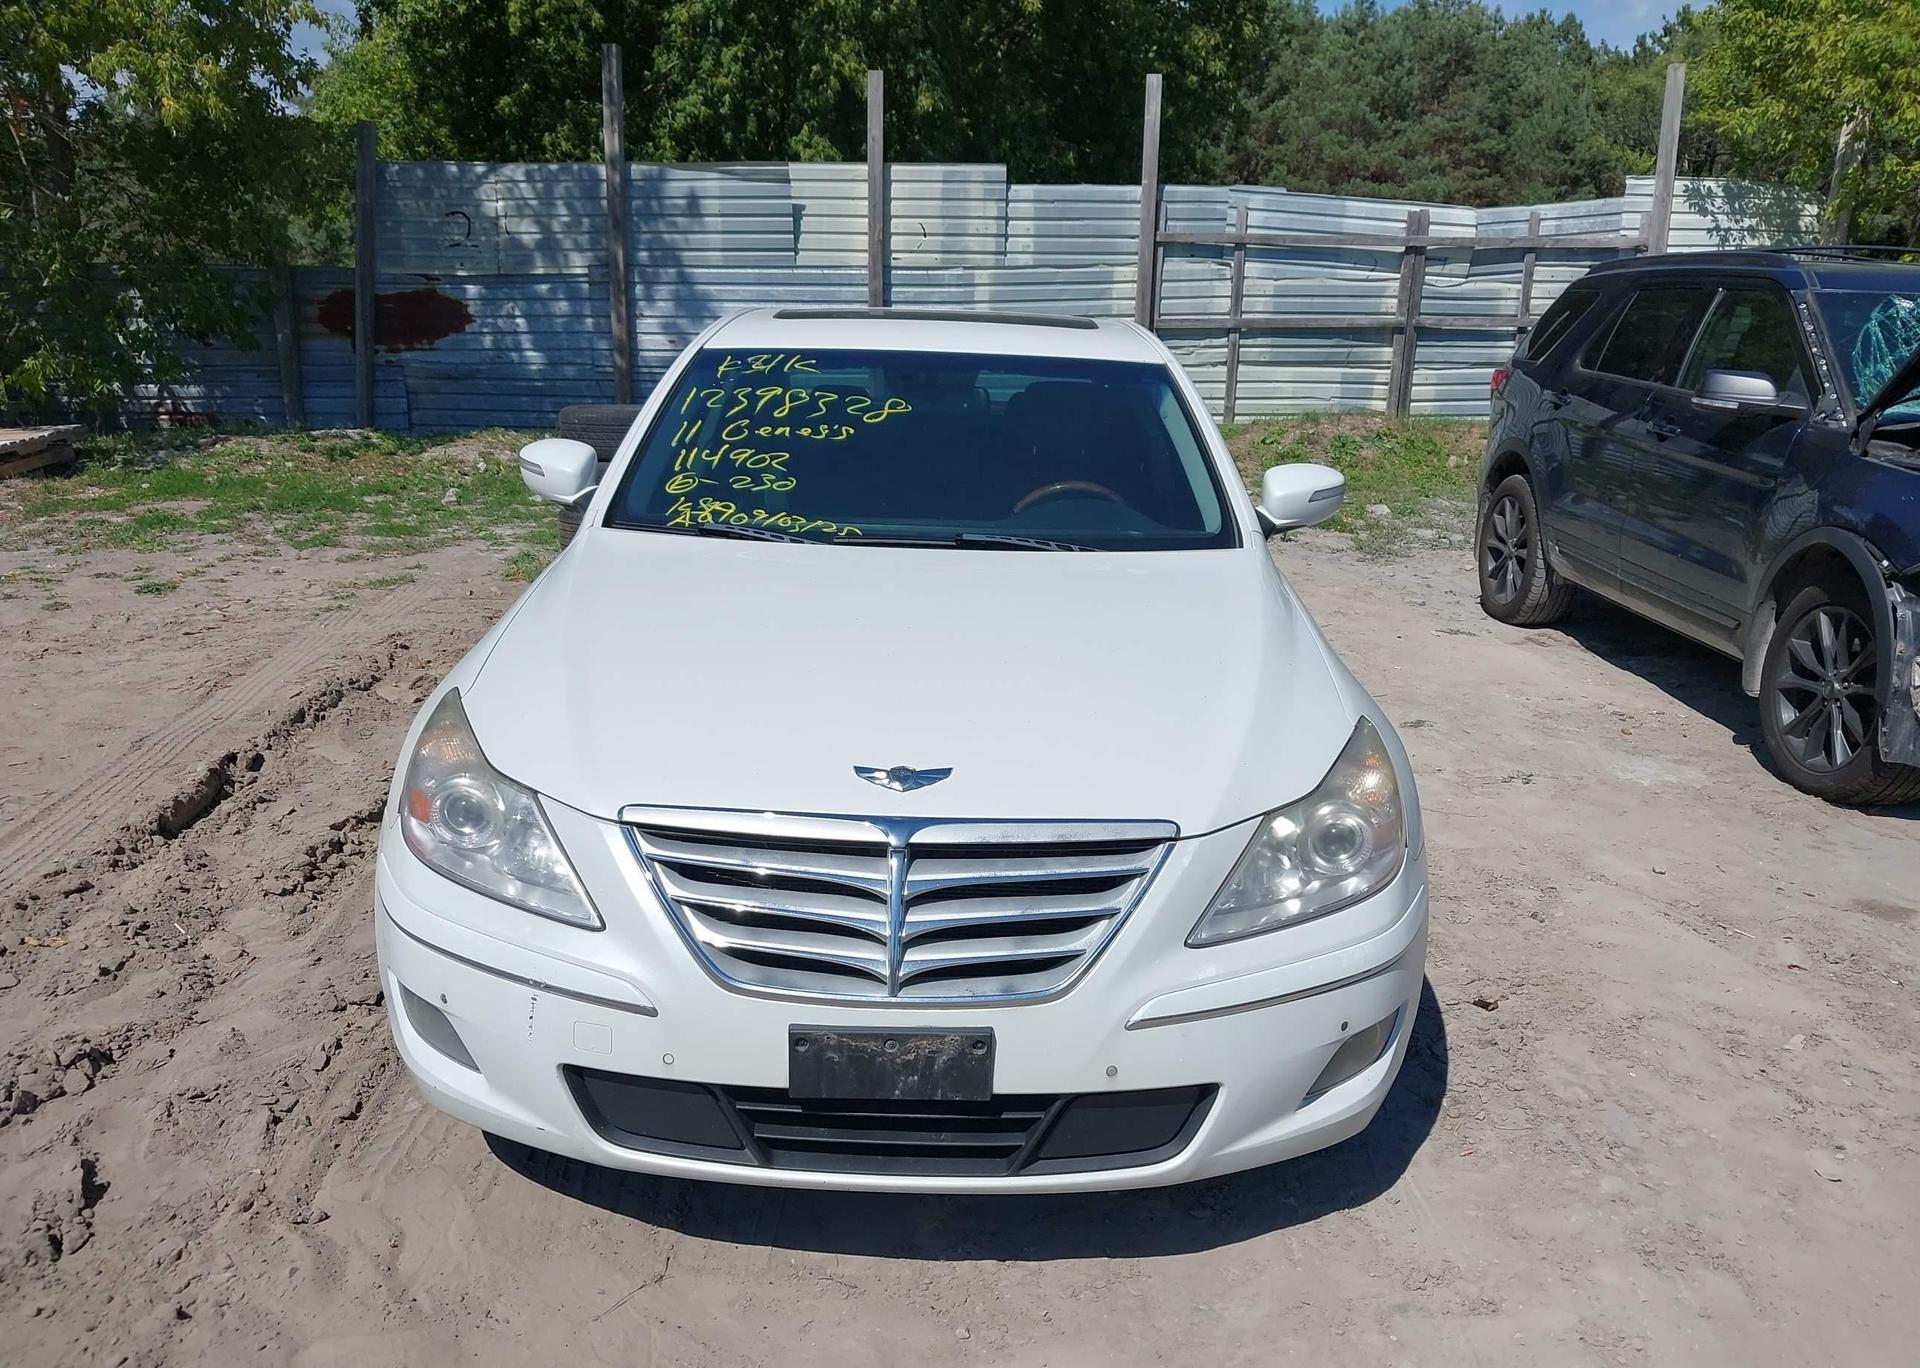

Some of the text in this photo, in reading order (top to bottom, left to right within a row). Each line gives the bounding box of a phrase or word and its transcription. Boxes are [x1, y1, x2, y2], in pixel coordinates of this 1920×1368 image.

[680, 386, 912, 422] 12398328
[671, 420, 701, 447] 11
[674, 444, 791, 471] 114902
[729, 474, 797, 491] 230
